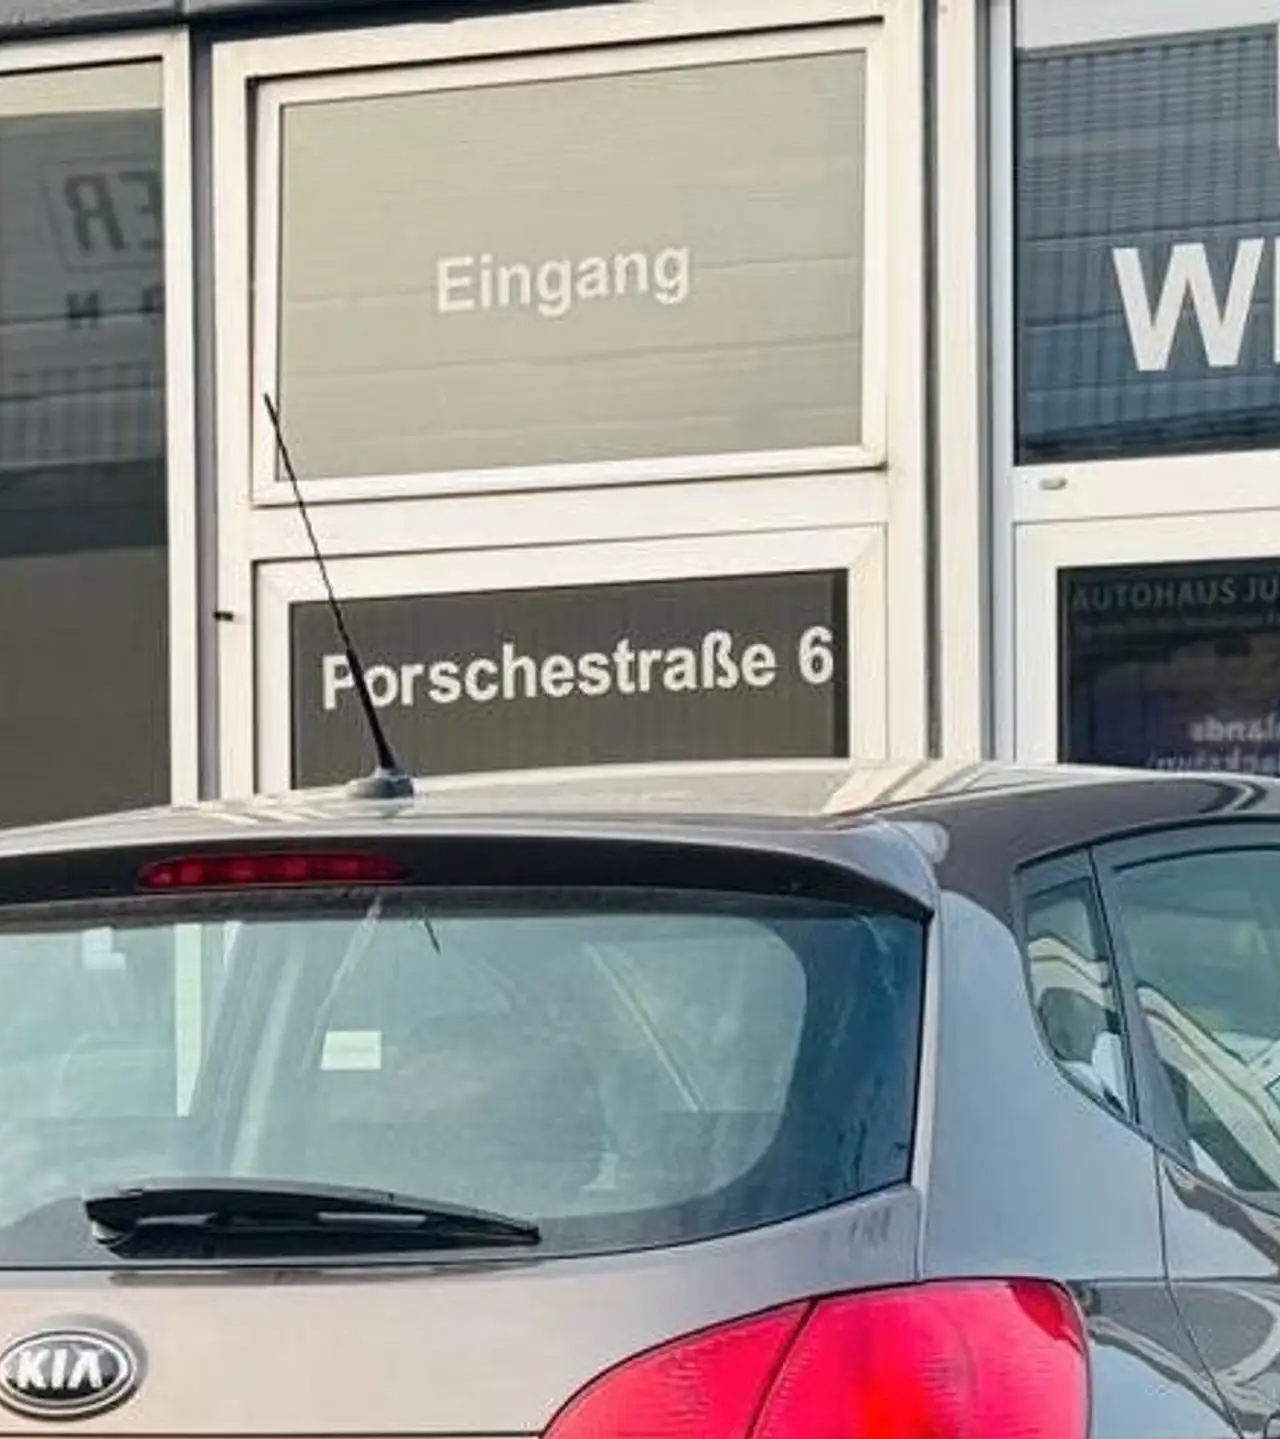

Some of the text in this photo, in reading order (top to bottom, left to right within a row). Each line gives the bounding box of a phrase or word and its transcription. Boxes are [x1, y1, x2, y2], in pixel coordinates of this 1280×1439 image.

[436, 246, 690, 318] Eingang
[1071, 576, 1238, 612] AUTOHAUS
[322, 625, 836, 710] Porschestraße 6
[17, 1348, 103, 1389] KIA
